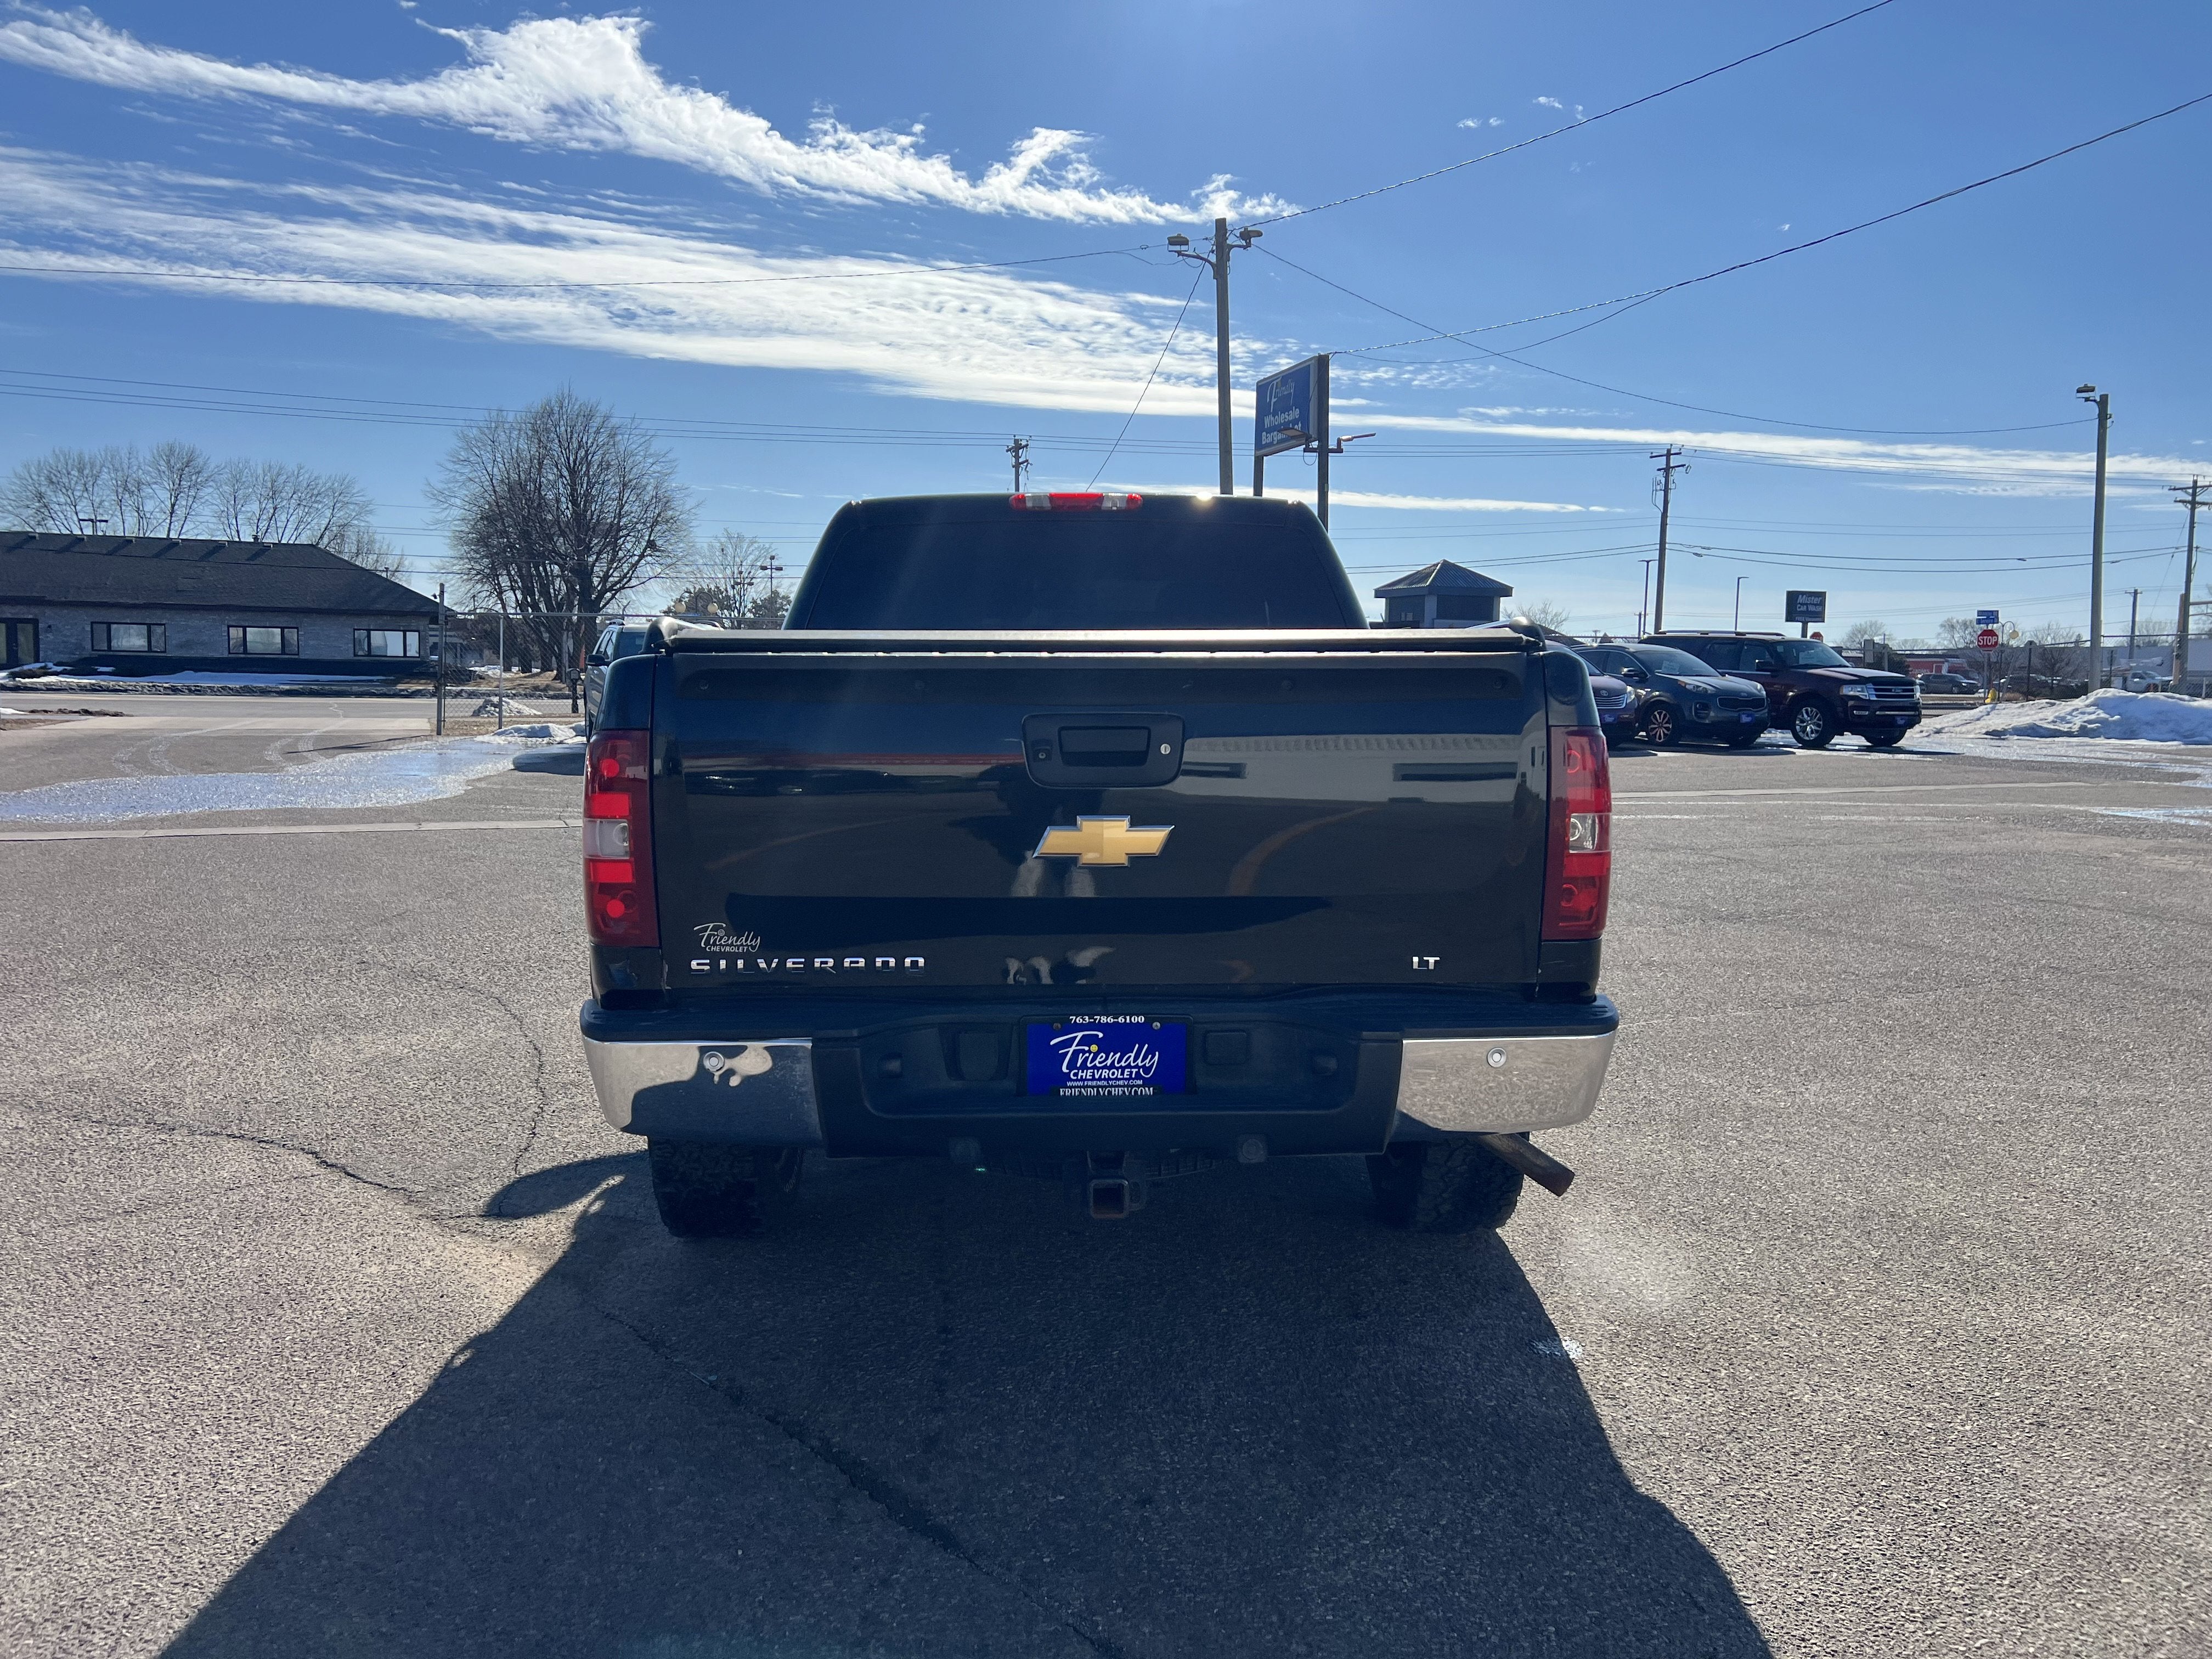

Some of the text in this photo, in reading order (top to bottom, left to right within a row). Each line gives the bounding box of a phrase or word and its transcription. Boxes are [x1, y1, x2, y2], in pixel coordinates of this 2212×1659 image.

[1265, 407, 1300, 428] Wholesale
[1262, 426, 1288, 444] Bargai
[1797, 594, 1822, 604] Mister
[1978, 636, 1997, 645] STOP
[693, 922, 760, 952] Friendly
[690, 956, 926, 974] SILVERADO
[1412, 956, 1440, 969] LT
[1069, 1015, 1145, 1024] 763-786-6100
[1049, 1031, 1159, 1078] Friendly
[1070, 1069, 1138, 1079] CHEVROLET
[1059, 1087, 1154, 1096] FRIENDLYCHEVCOM
